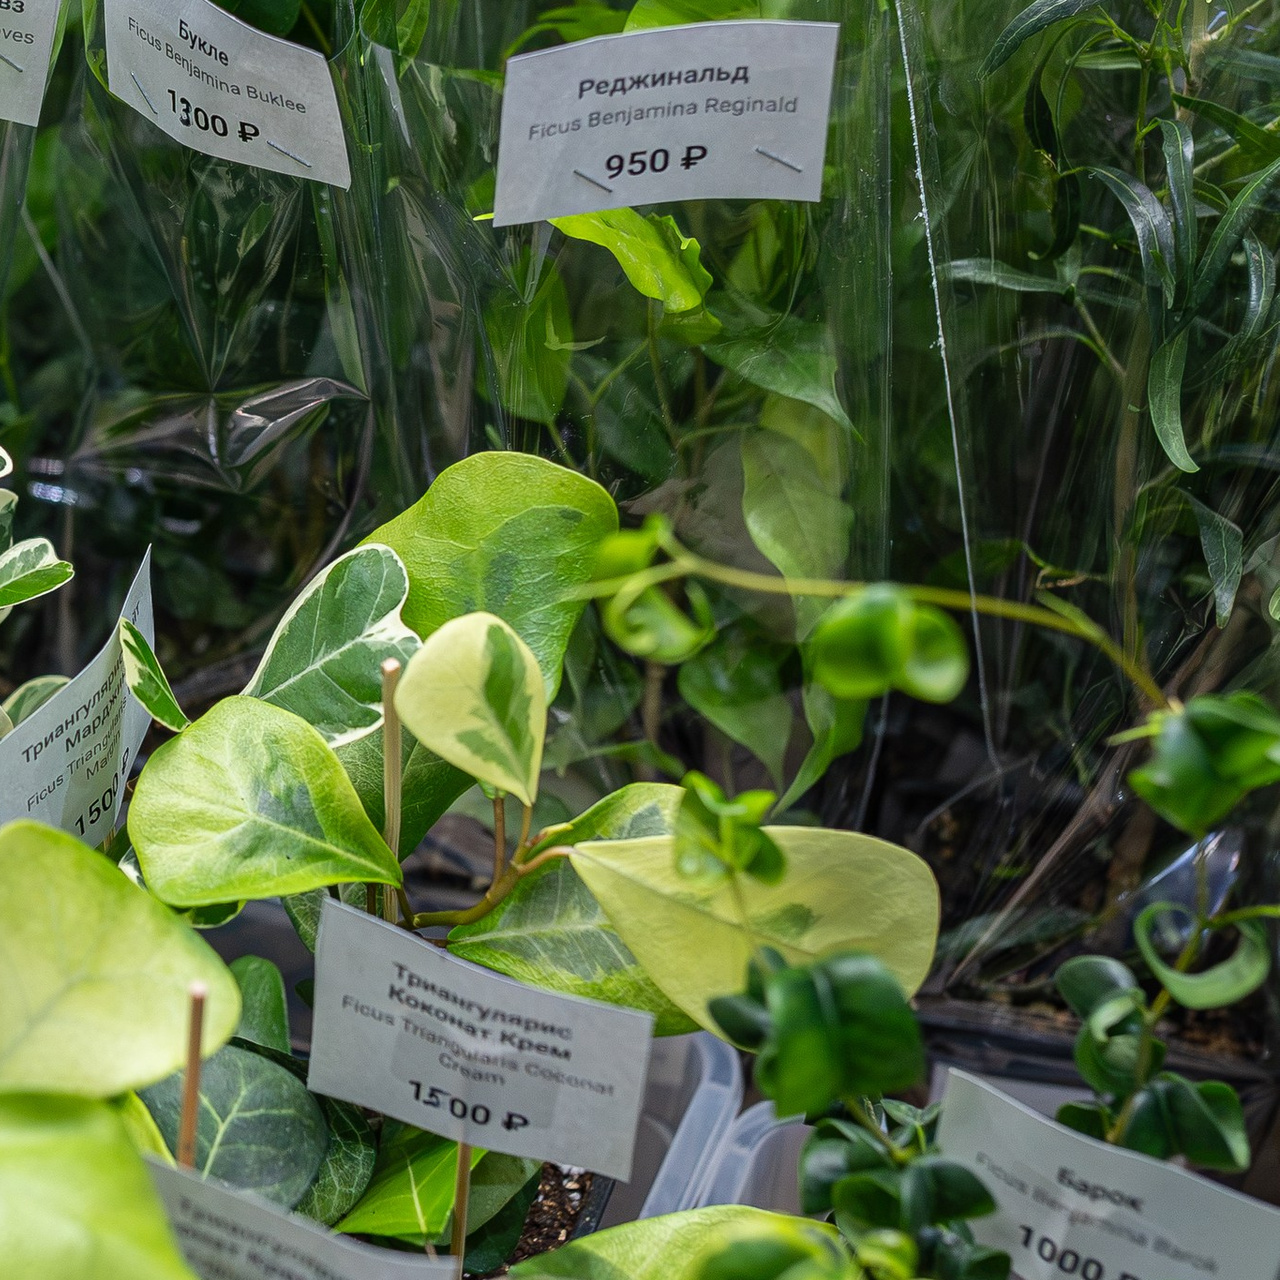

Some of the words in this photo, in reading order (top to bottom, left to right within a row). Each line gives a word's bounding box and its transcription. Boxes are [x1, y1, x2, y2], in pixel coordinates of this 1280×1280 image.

[128, 17, 162, 51] Ficus
[165, 42, 241, 96] Benjamina
[246, 85, 306, 114] Buklee
[178, 19, 229, 67] Букле
[578, 66, 750, 99] Реджинальд
[167, 88, 229, 137] 1300
[528, 117, 581, 140] Ficus
[588, 102, 698, 128] Benjamina
[705, 96, 798, 117] Reginald
[605, 148, 670, 180] 950
[26, 774, 64, 812] Ficus
[75, 772, 119, 836] 1500
[388, 984, 493, 1040] Коконат
[499, 1029, 573, 1061] Крем
[392, 961, 573, 1041] Триангулярис
[341, 994, 395, 1027] Ficus
[402, 1018, 520, 1071] Triangularis
[438, 1052, 507, 1086] Cream
[408, 1080, 491, 1126] 1500
[1056, 1167, 1145, 1212] Барок
